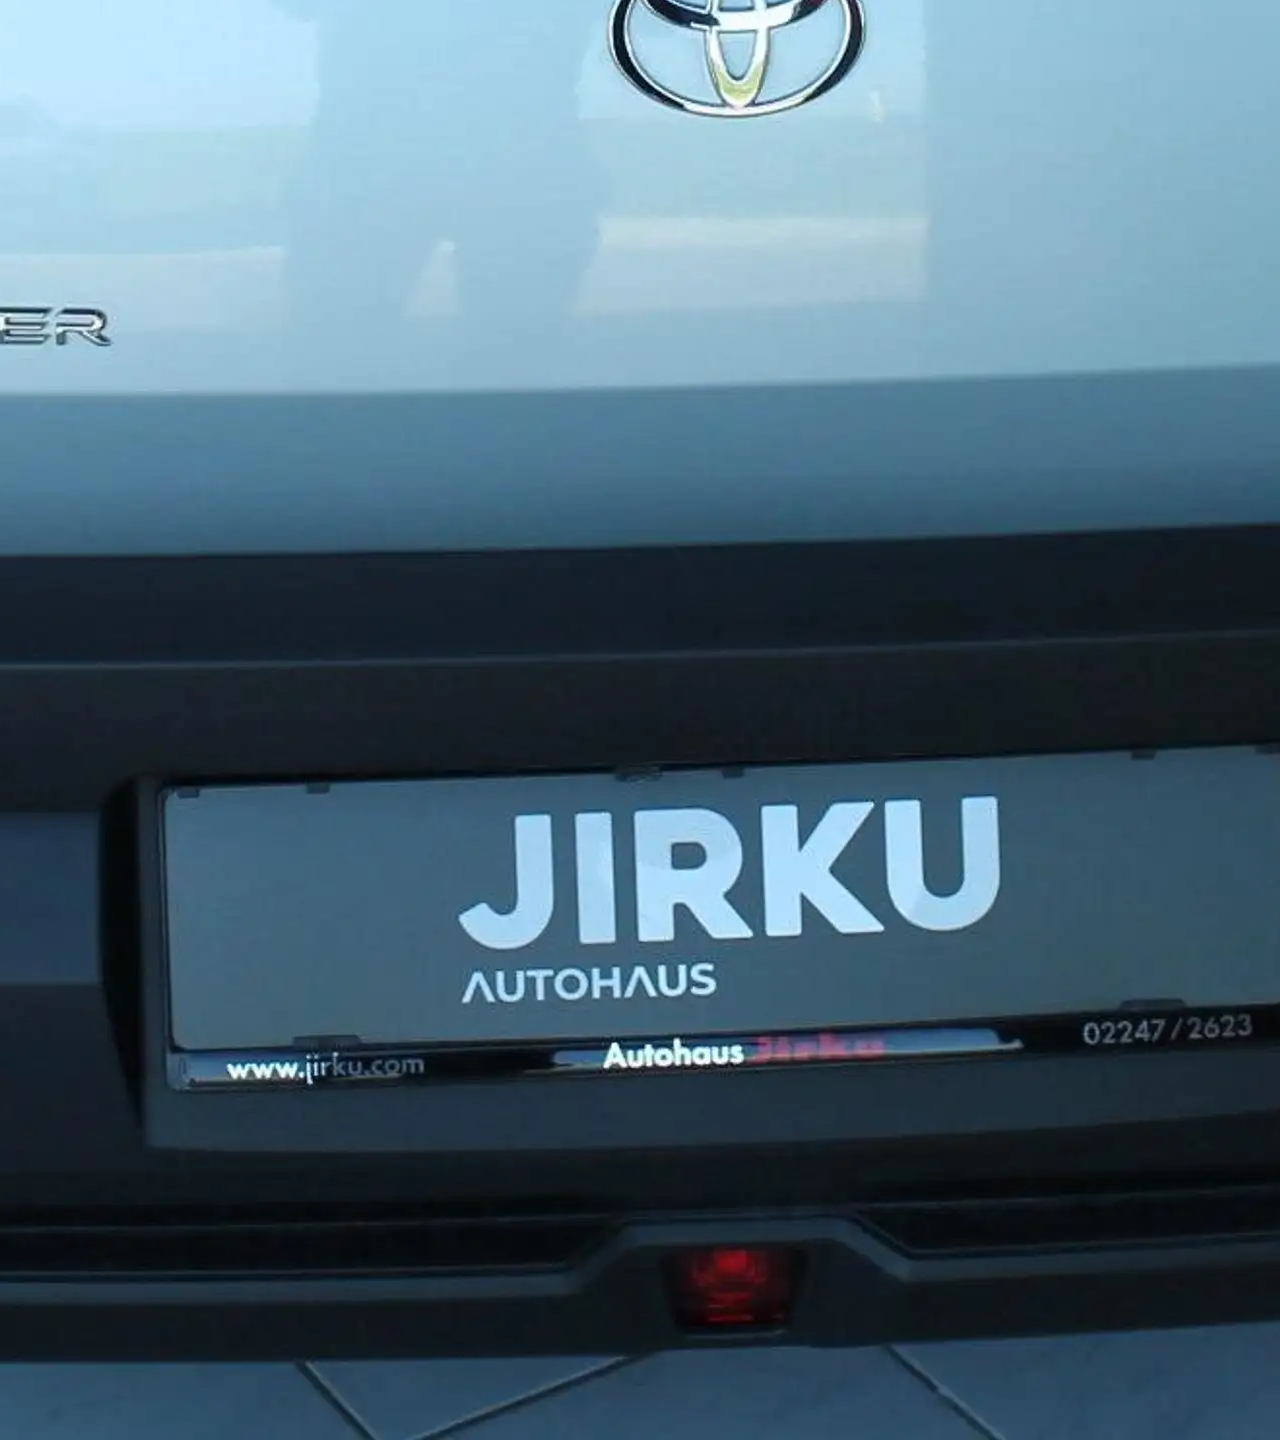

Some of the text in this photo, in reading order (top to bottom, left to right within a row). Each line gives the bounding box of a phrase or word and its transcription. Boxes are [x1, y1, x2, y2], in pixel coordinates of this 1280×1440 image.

[458, 794, 1002, 951] JIRKU
[461, 961, 718, 1005] AUTOHAUS
[226, 1052, 426, 1085] www.jirku.com
[602, 1039, 745, 1071] Autohaus
